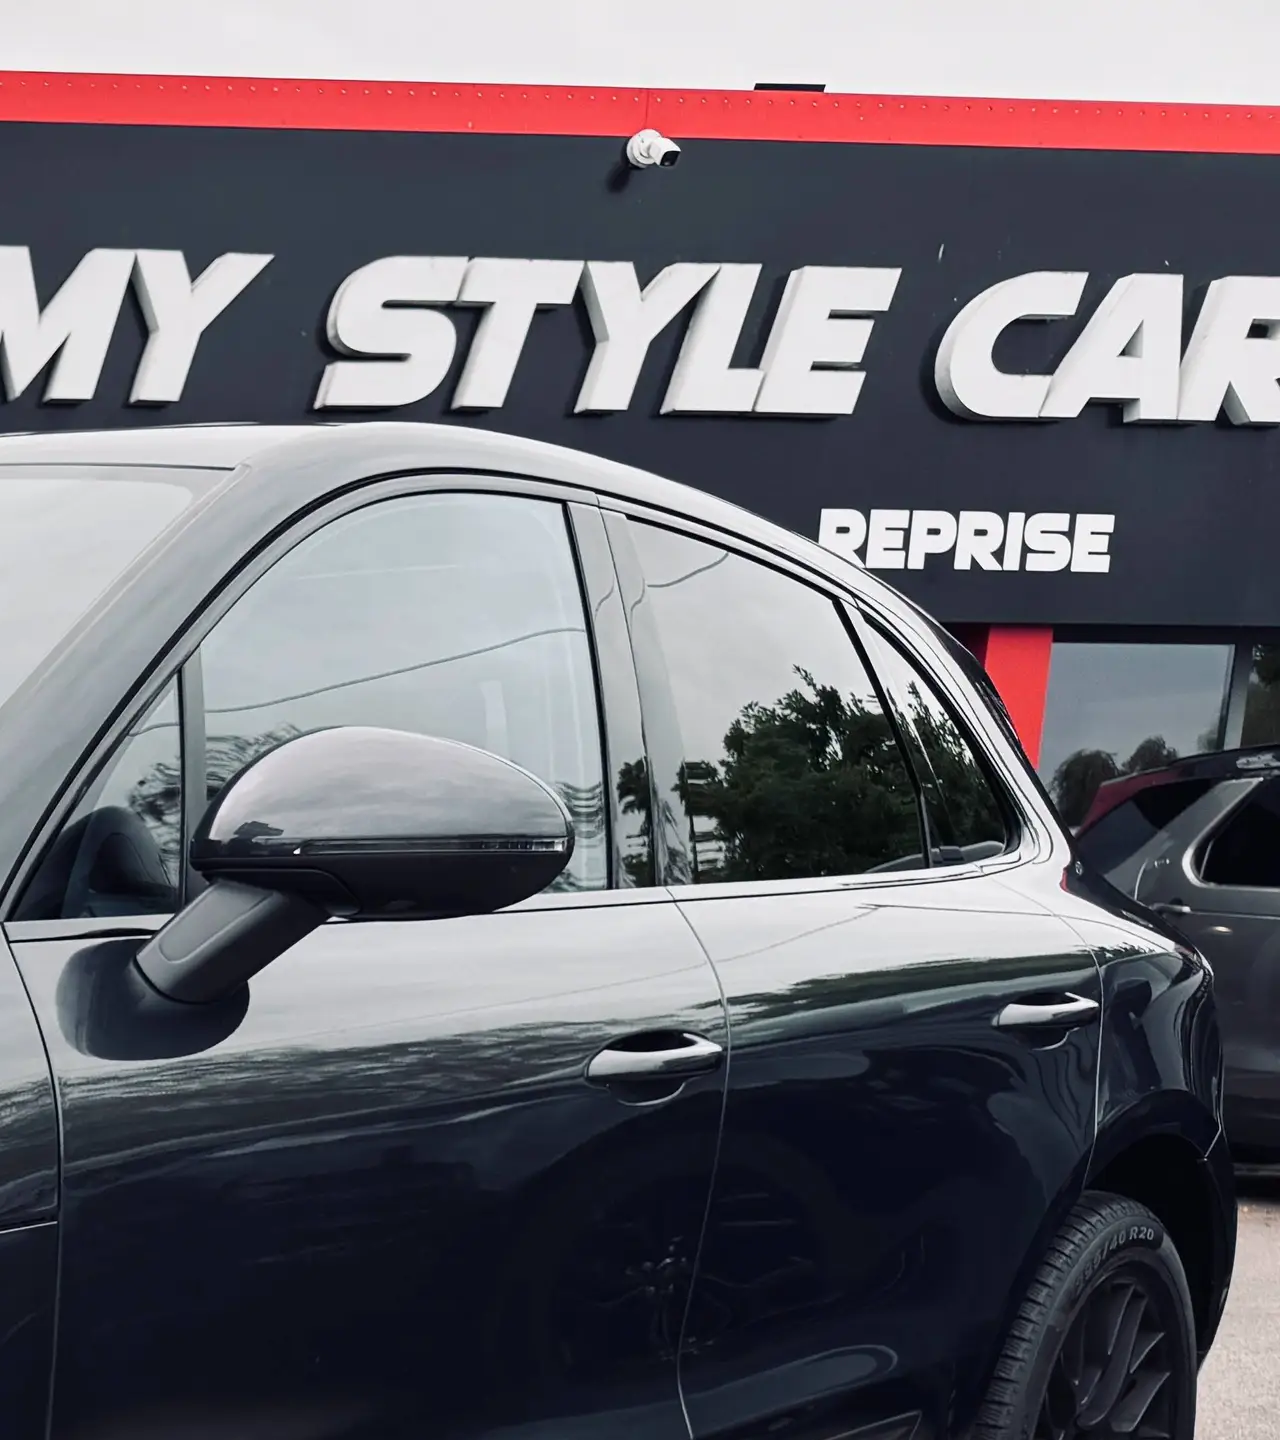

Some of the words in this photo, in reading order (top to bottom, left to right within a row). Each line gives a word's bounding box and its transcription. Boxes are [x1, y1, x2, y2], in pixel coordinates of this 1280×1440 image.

[313, 254, 903, 418] STYLE
[936, 270, 1280, 425] CAR
[818, 508, 1116, 573] REPRISE
[1129, 1226, 1155, 1241] R20
